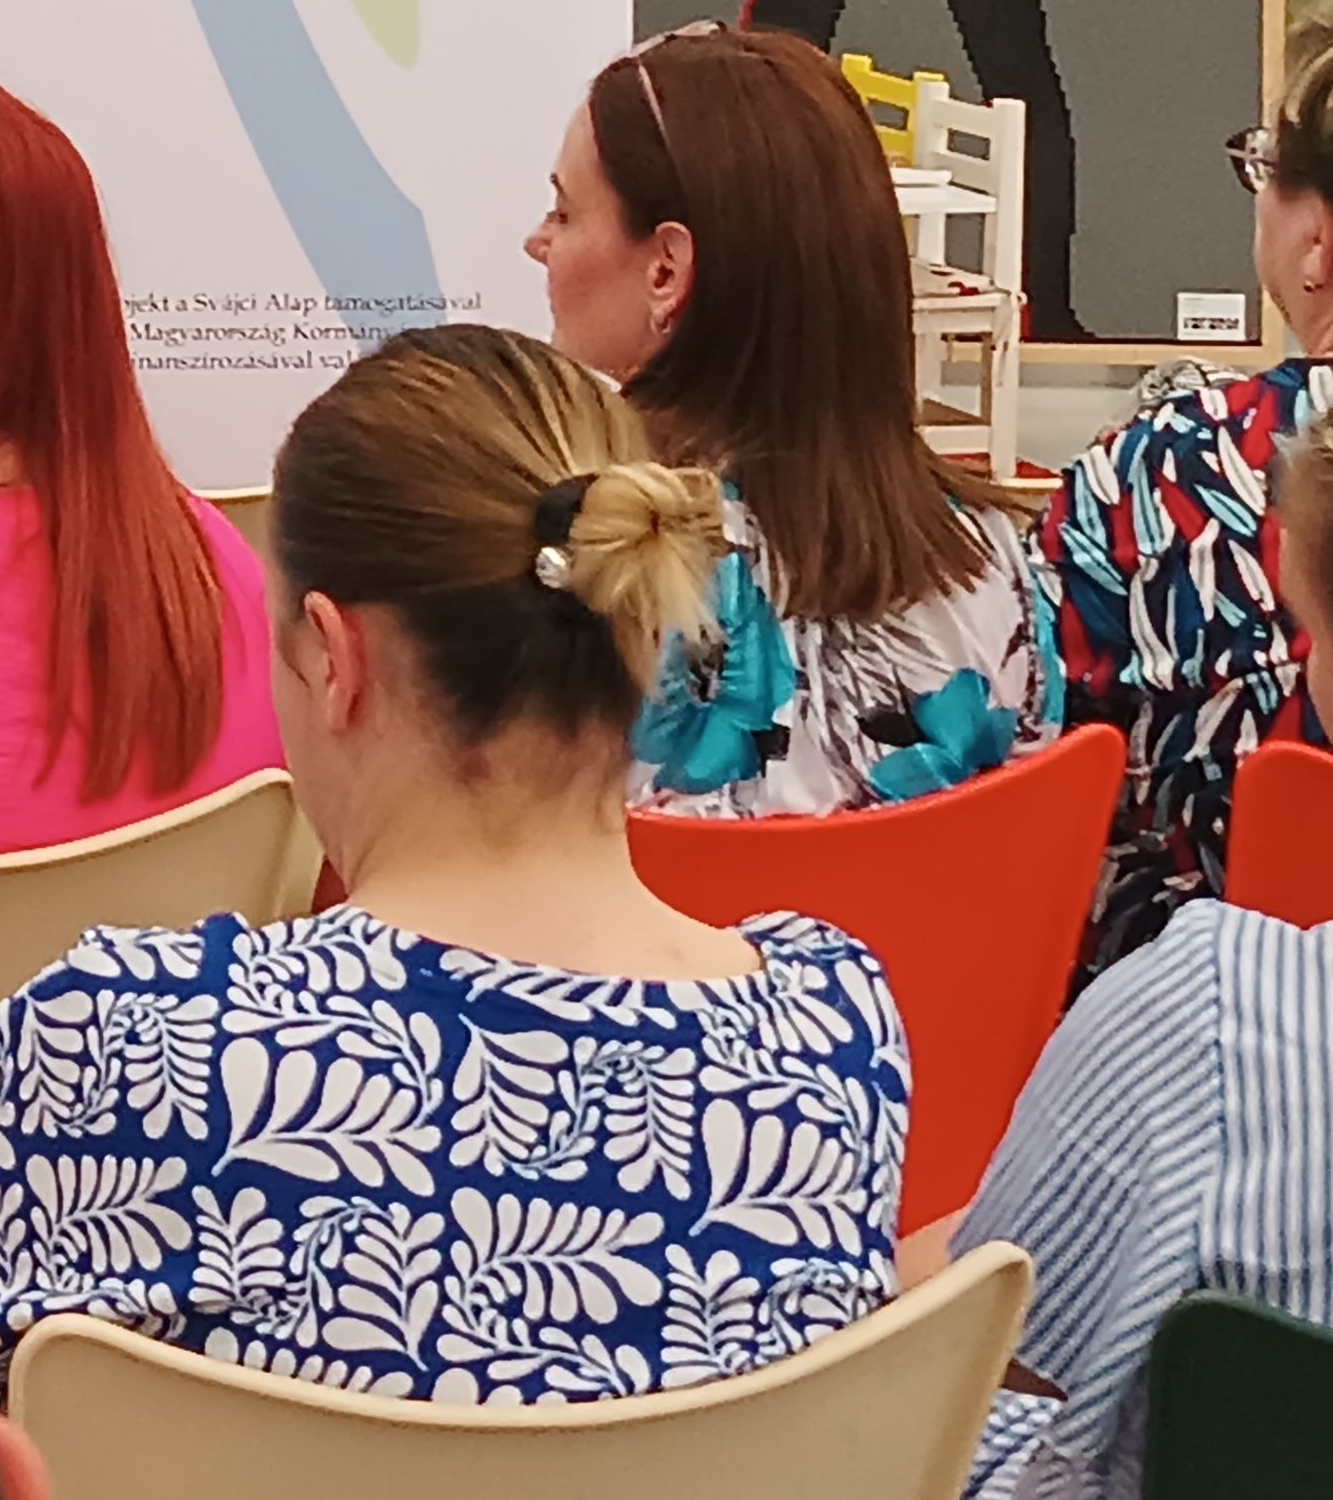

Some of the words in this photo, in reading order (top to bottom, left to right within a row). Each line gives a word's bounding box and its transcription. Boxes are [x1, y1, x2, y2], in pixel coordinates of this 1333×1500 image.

[125, 292, 169, 318] jekt
[175, 298, 189, 312] a
[264, 292, 318, 317] Alap
[319, 350, 353, 370] val
